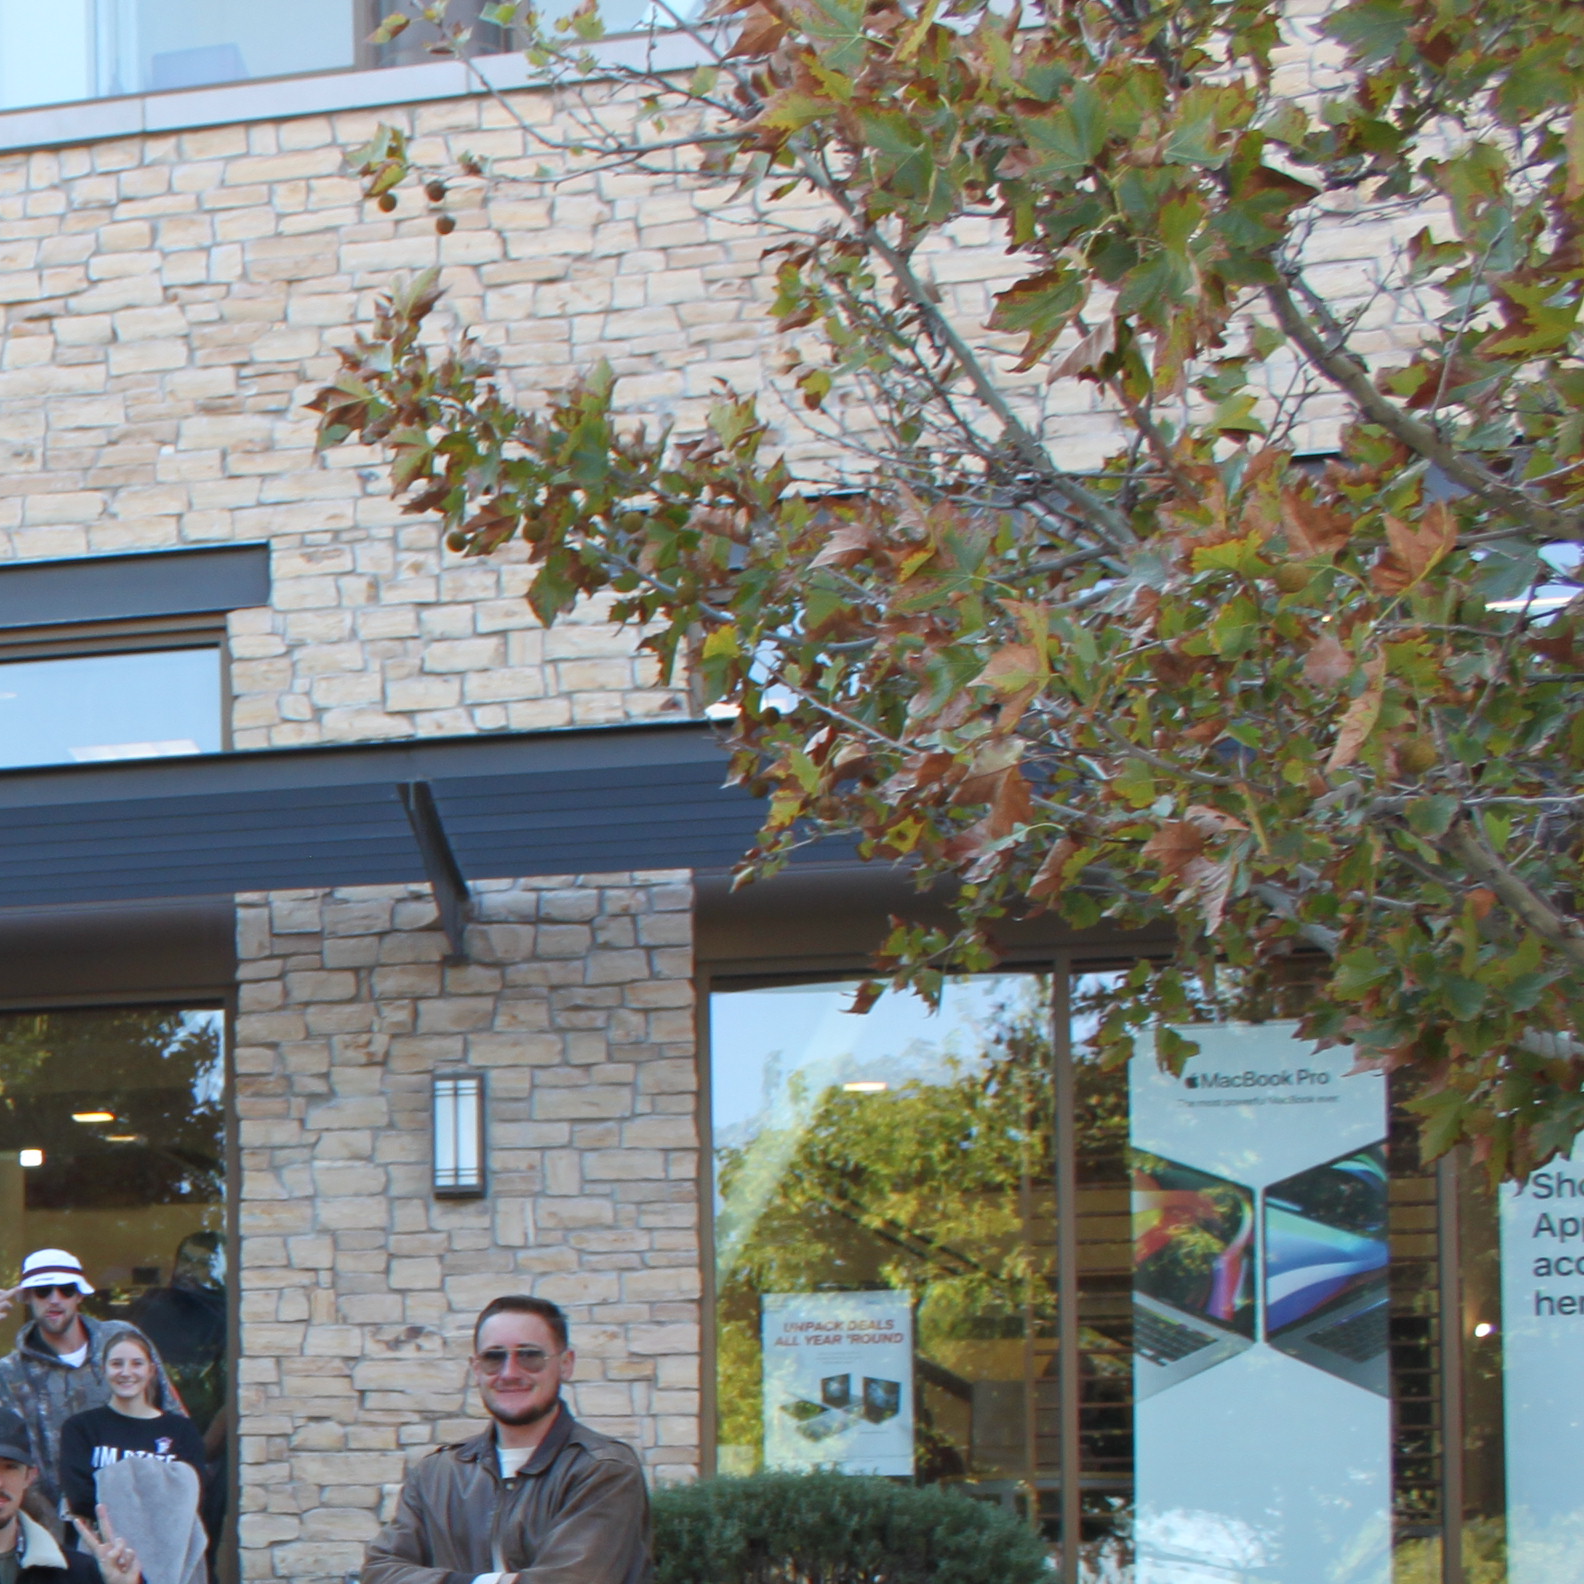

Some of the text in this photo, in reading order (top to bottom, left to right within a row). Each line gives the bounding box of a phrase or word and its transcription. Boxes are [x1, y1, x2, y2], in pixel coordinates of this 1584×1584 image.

[1201, 1069, 1330, 1088] MacBook Pro
[1532, 1213, 1584, 1243] Ap
[847, 1318, 895, 1332] DEALS
[775, 1335, 799, 1347] ALL
[805, 1333, 842, 1346] YEAR
